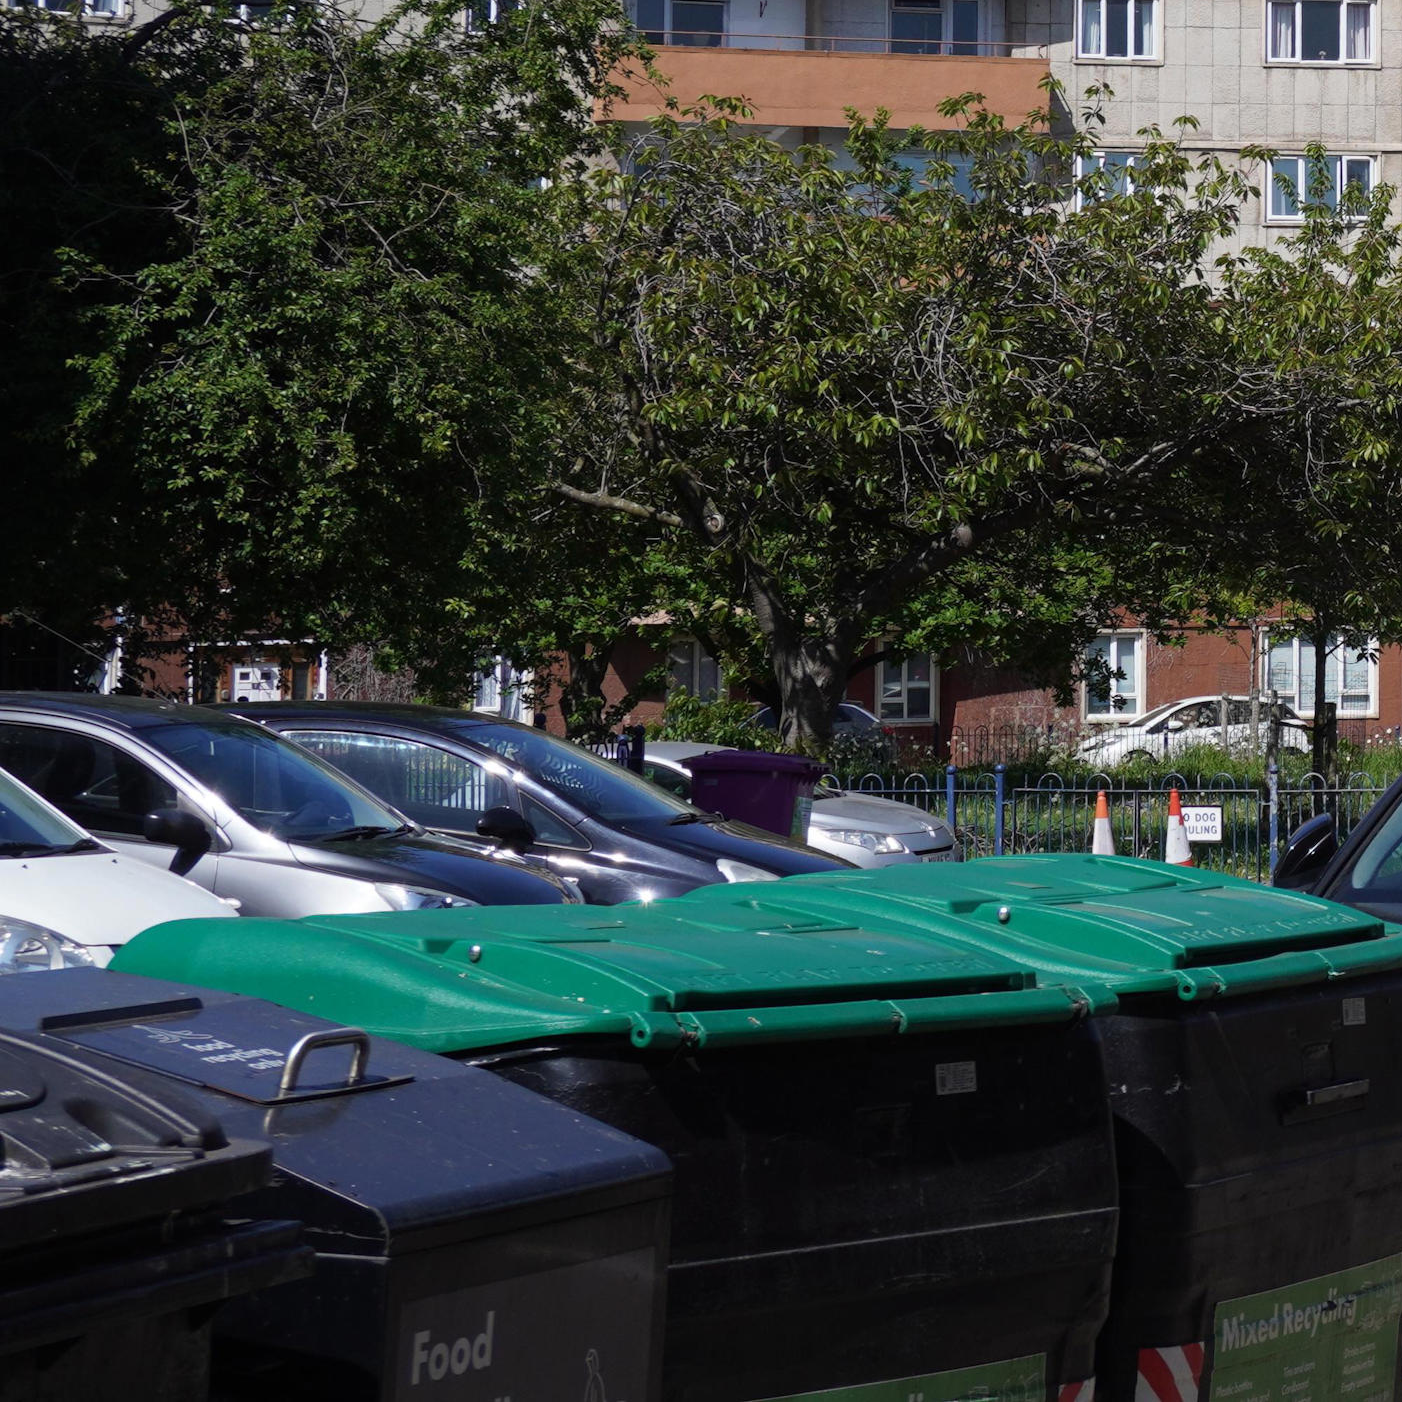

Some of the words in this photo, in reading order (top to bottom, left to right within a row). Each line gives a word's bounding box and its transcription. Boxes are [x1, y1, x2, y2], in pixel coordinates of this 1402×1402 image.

[1188, 825, 1218, 835] ULING
[1195, 812, 1217, 822] DOG
[1221, 1303, 1279, 1352] Mixed
[1283, 1287, 1358, 1338] Recycling
[411, 1310, 496, 1386] Food
